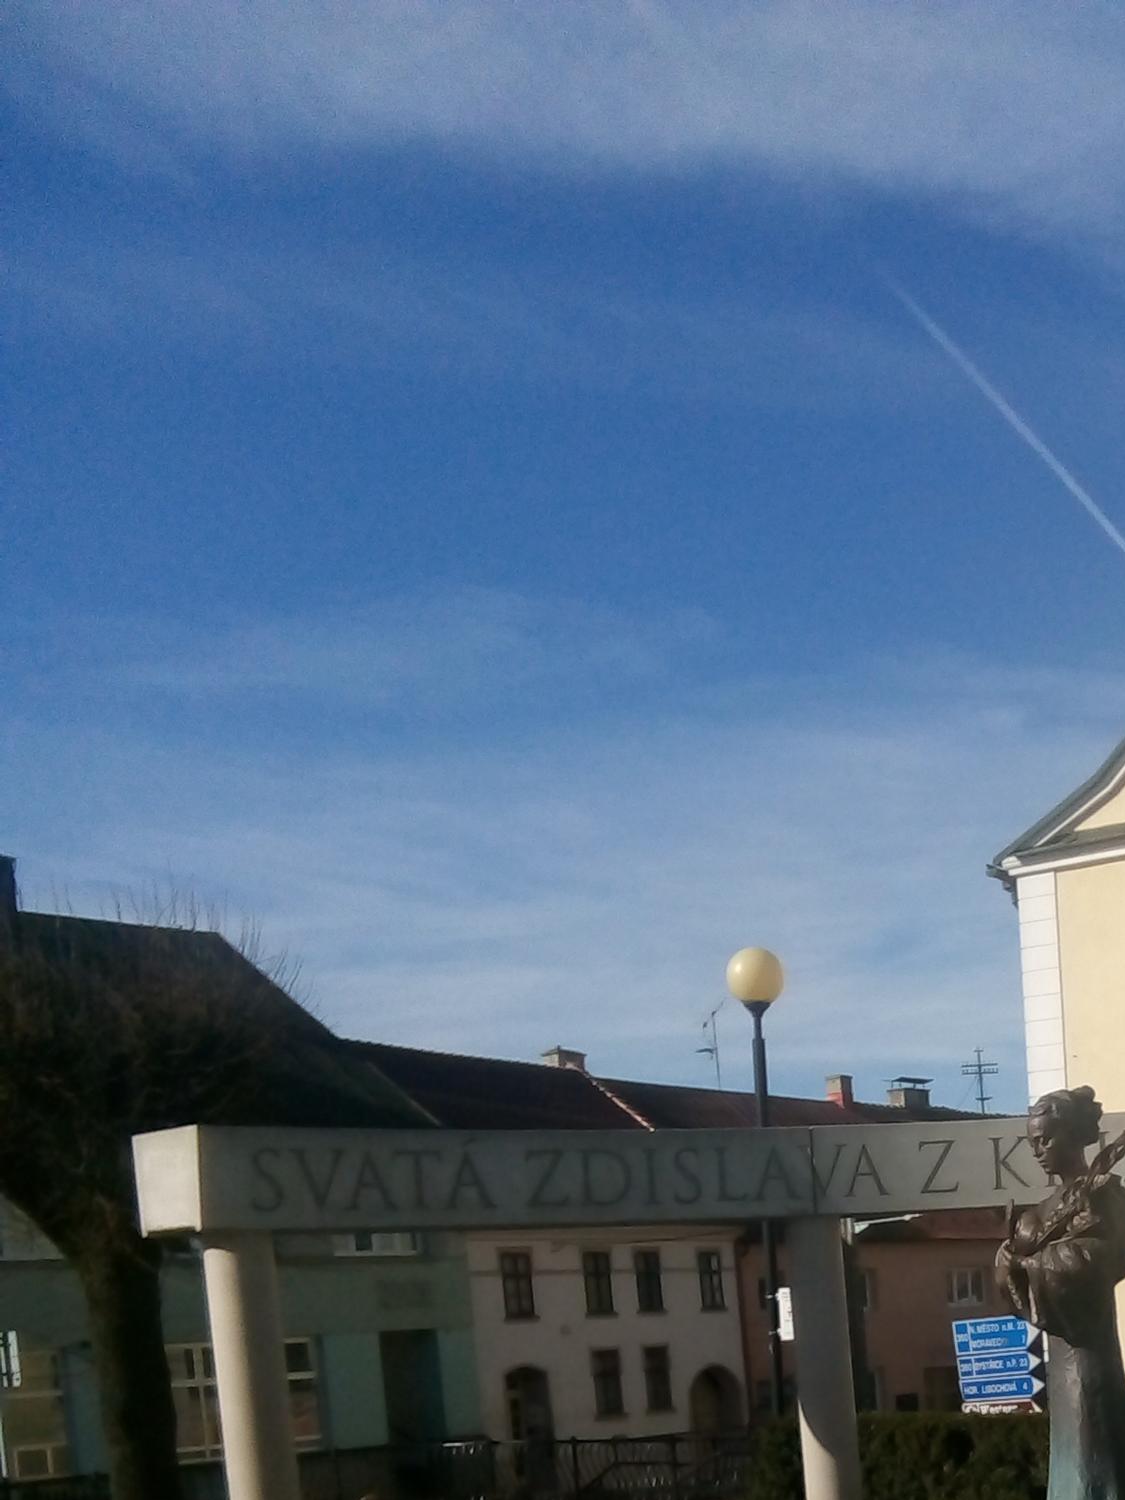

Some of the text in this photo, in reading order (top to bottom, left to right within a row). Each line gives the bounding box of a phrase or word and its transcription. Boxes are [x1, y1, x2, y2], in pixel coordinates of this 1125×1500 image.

[249, 1138, 499, 1212] SVATÁ
[525, 1143, 892, 1208] ZDISLAVA
[918, 1140, 960, 1194] Z
